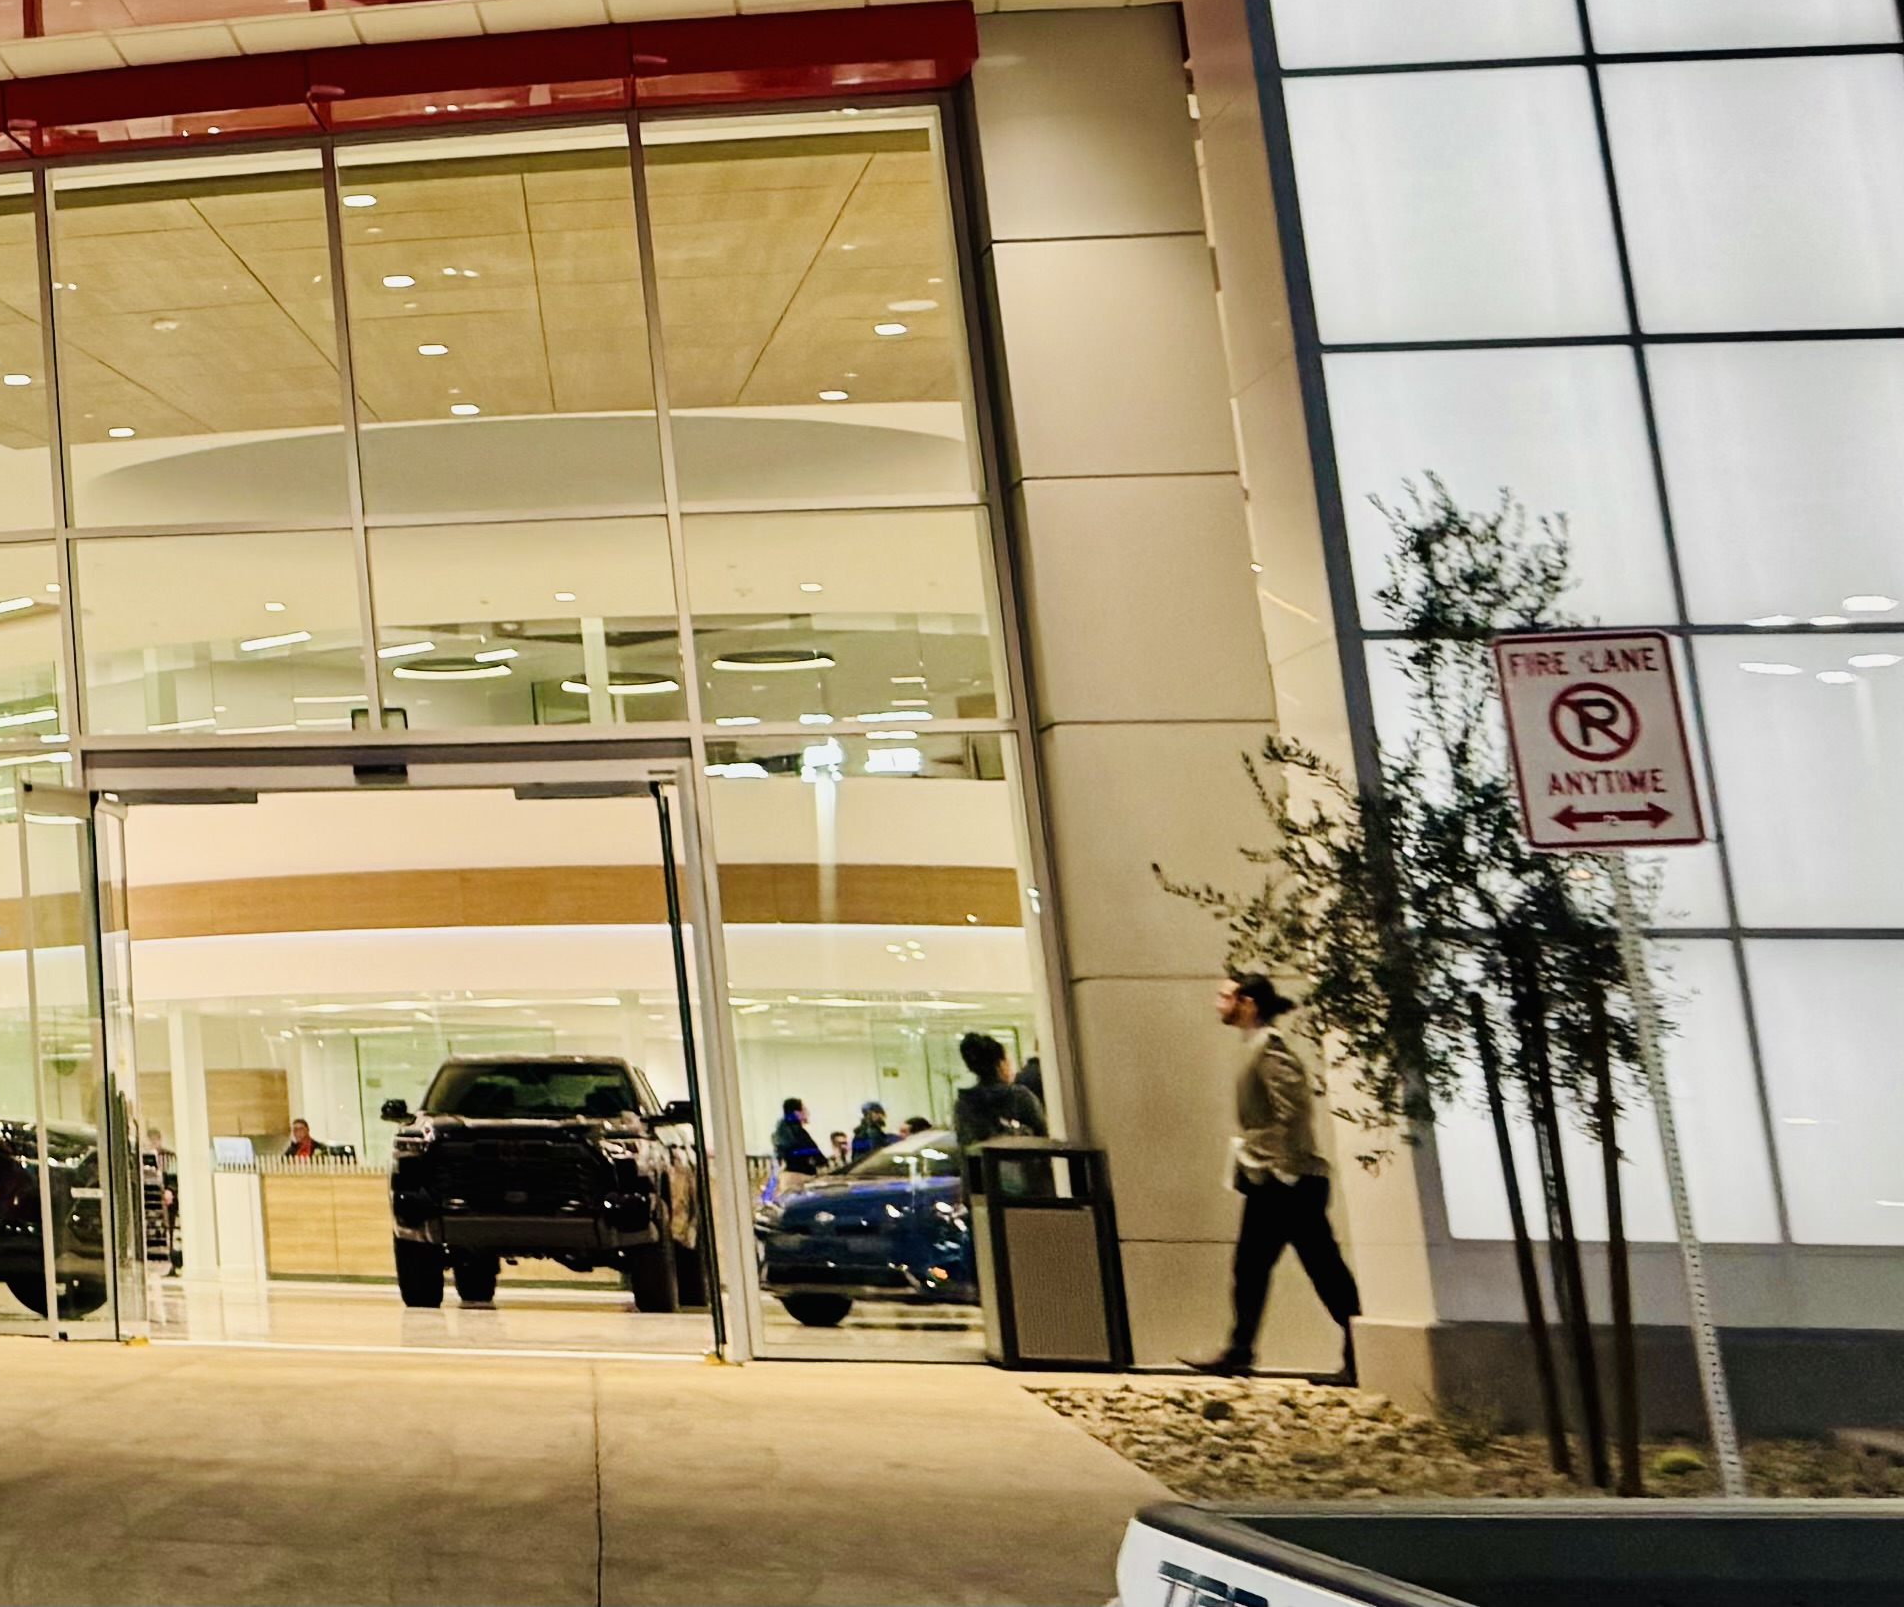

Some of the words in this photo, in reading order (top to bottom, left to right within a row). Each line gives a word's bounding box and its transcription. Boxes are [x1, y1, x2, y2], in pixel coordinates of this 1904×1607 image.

[1508, 651, 1569, 677] FIRE
[1588, 647, 1659, 674] LANE
[1549, 768, 1668, 796] ANYTIME
